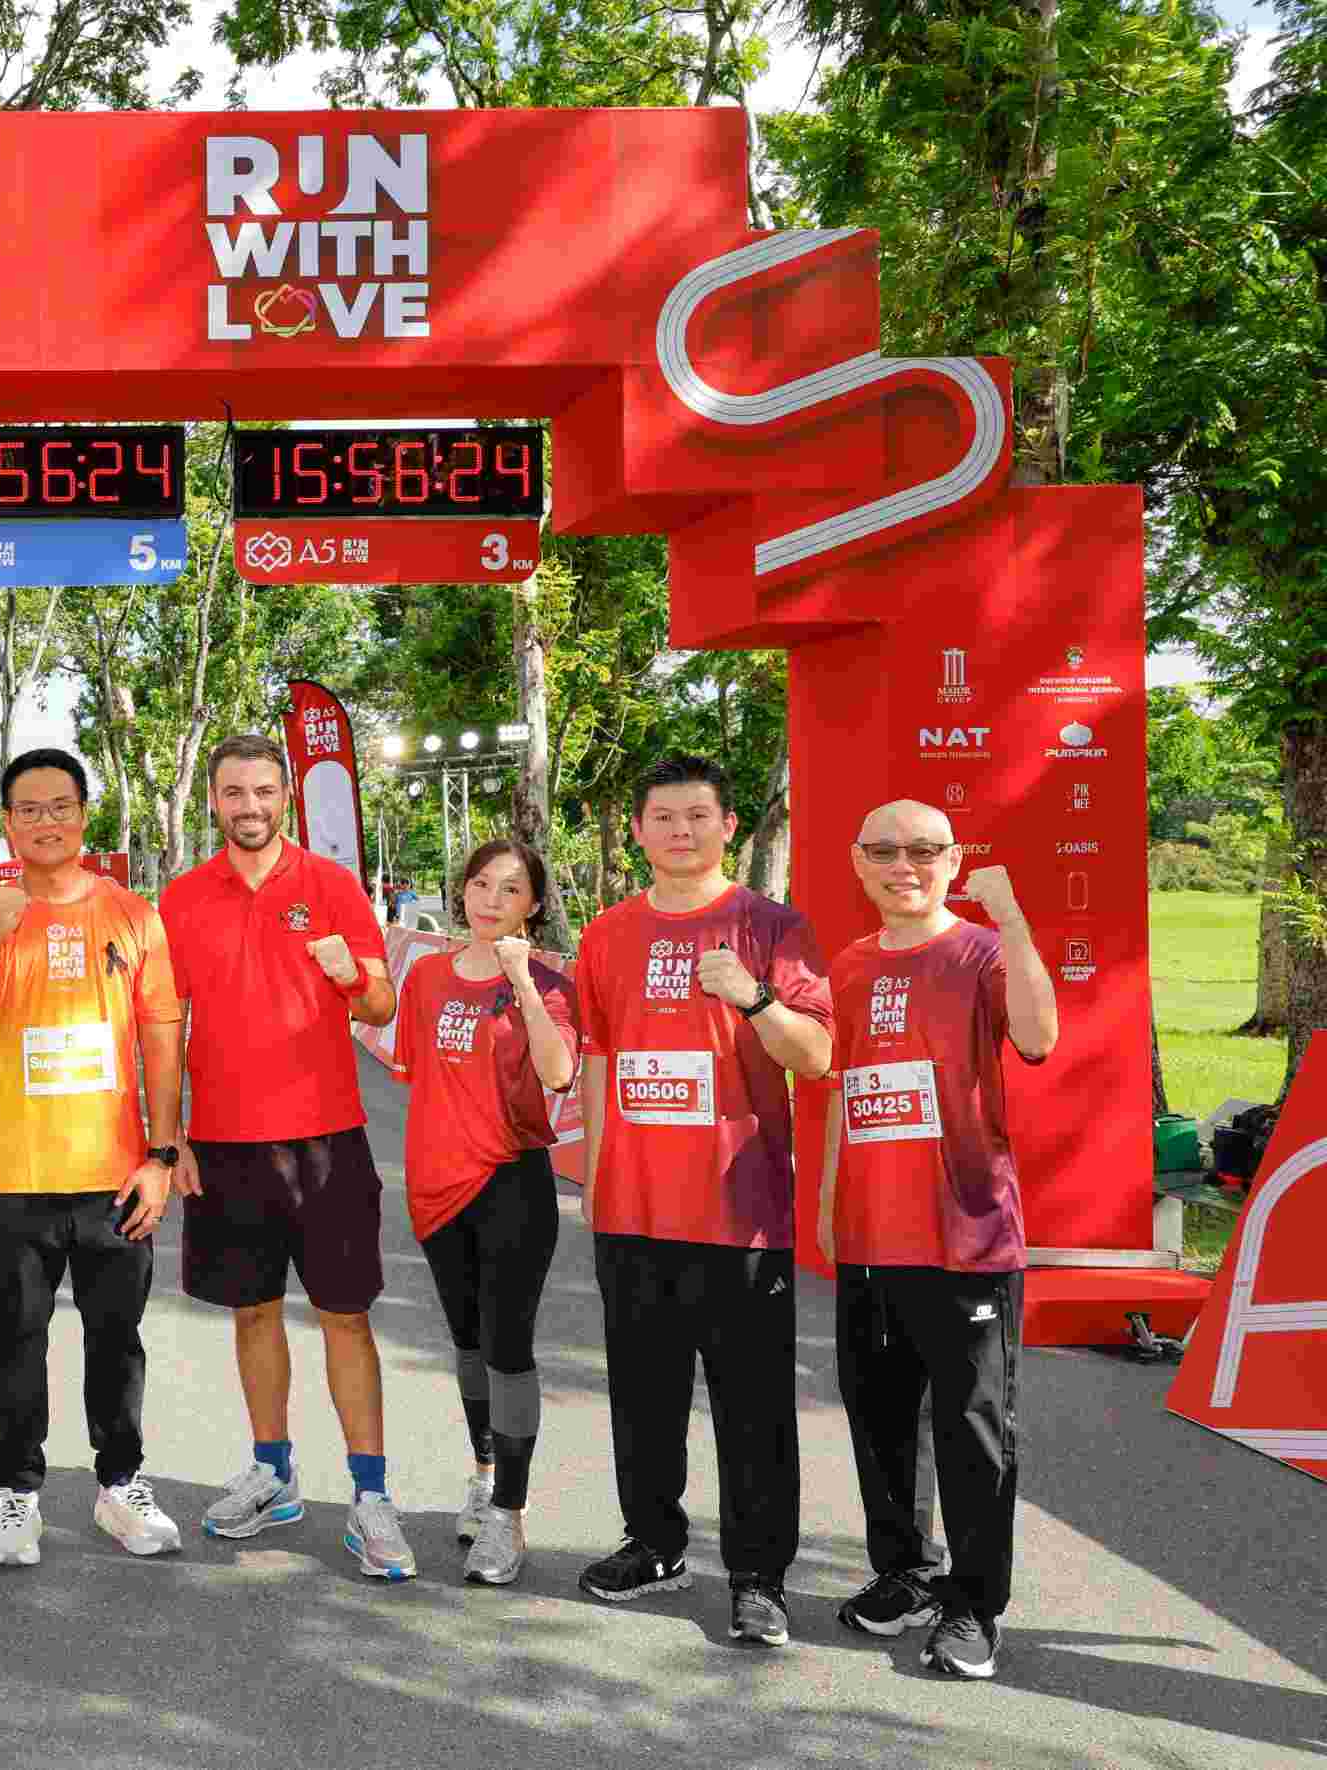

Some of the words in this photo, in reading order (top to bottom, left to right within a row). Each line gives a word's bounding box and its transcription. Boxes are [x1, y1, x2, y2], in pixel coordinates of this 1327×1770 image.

[206, 134, 428, 216] RUN
[204, 220, 428, 278] WITH
[207, 283, 431, 340] LOVE
[273, 442, 529, 503] 15:56:24
[129, 534, 157, 571] 5
[298, 539, 336, 564] A5
[480, 532, 509, 570] 3
[513, 559, 533, 570] KM
[919, 728, 991, 746] NAT
[647, 958, 692, 975] RUN
[648, 1059, 659, 1076] 3
[626, 1082, 689, 1100] 30506
[870, 1074, 881, 1089] 3
[852, 1094, 912, 1118] 30425
